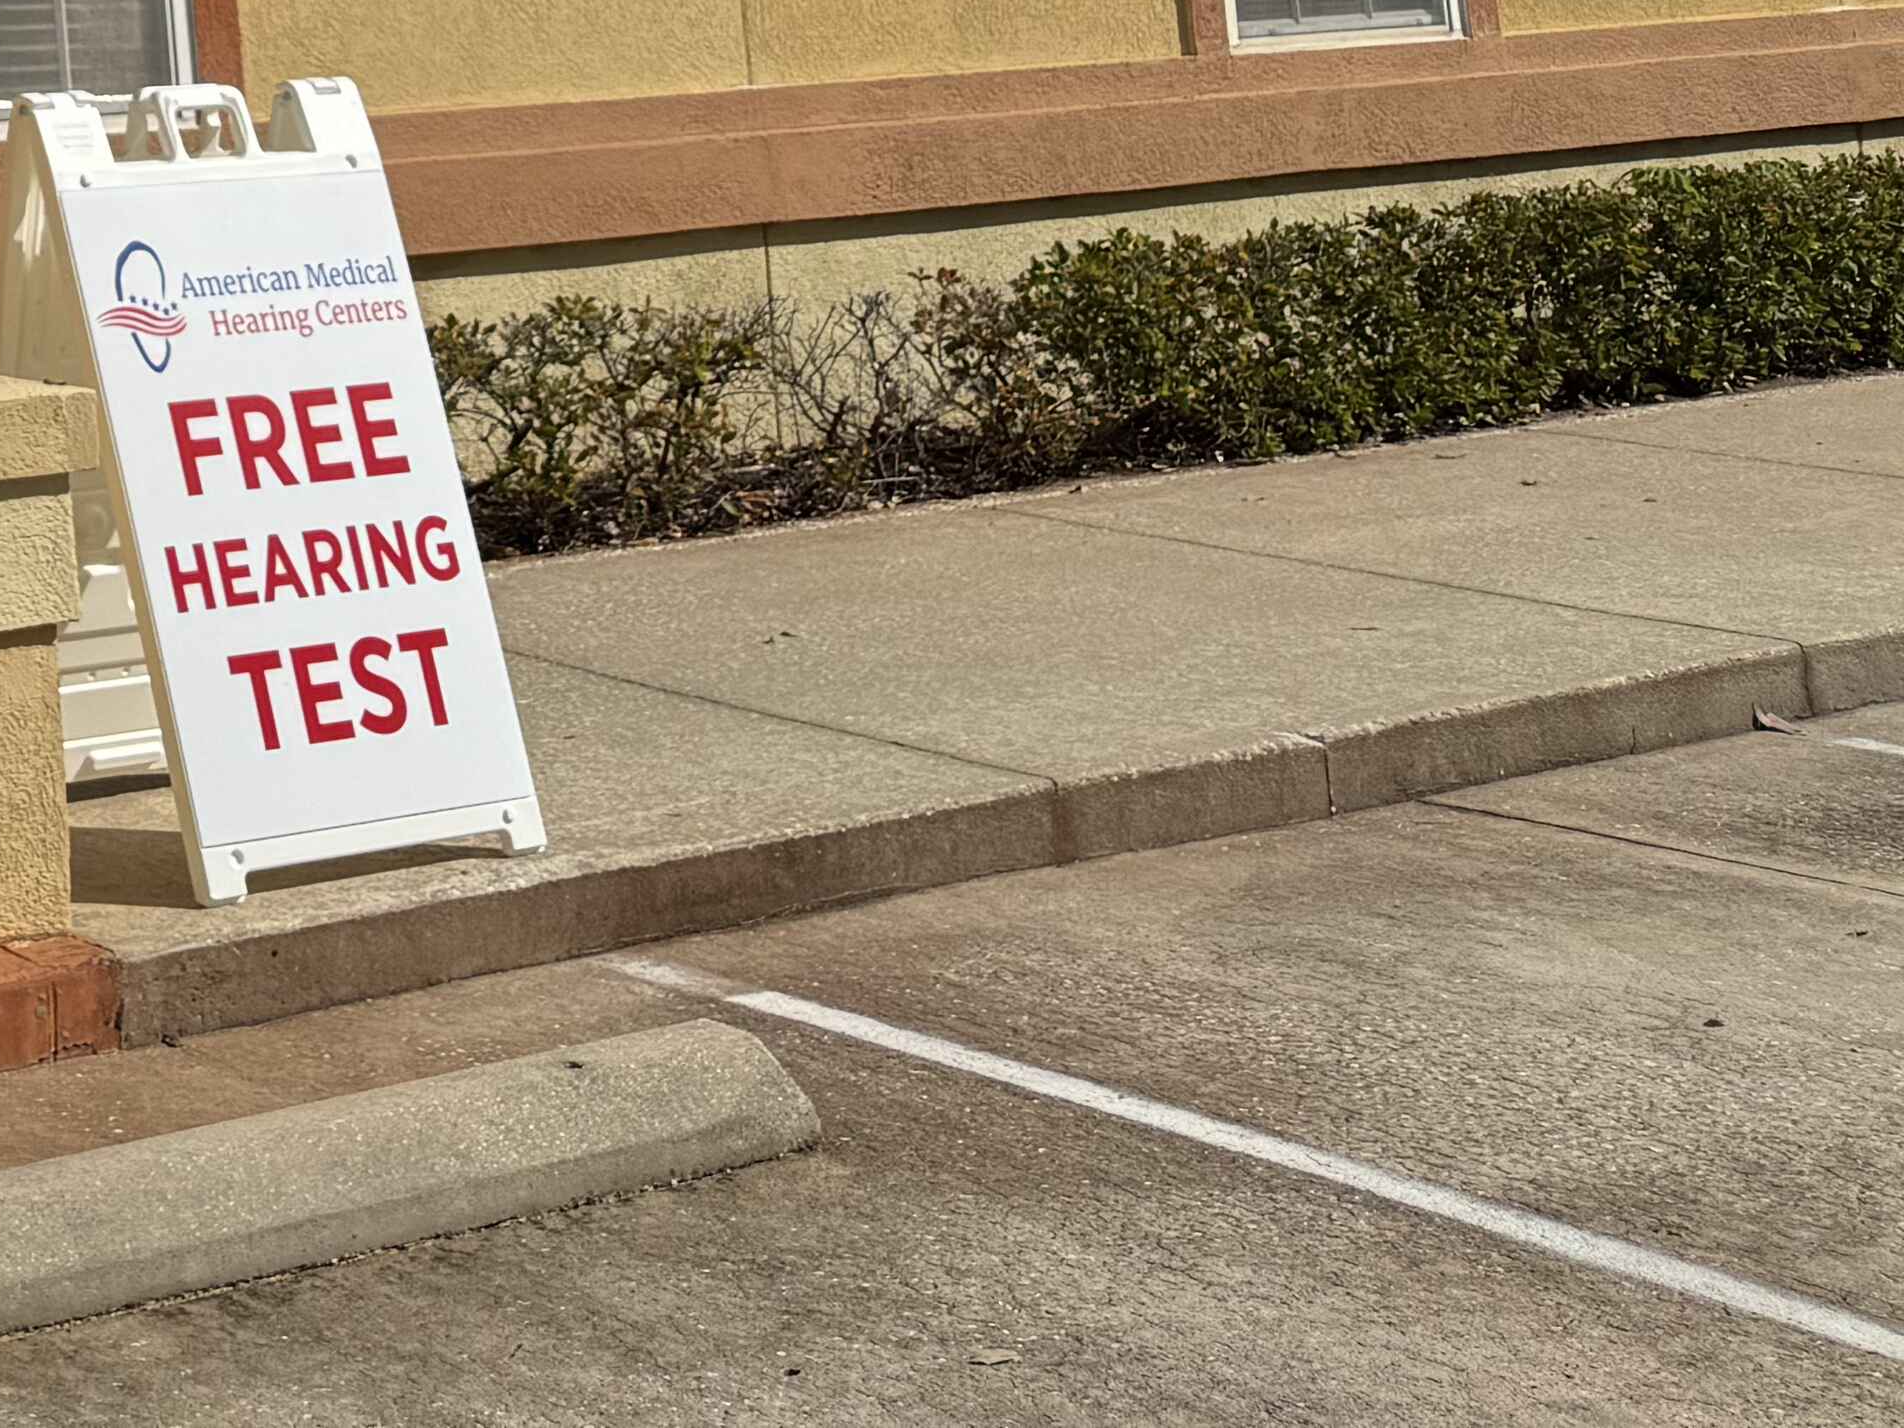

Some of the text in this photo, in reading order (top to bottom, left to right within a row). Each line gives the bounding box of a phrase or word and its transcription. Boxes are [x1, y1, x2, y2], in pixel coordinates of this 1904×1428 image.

[181, 256, 398, 298] American Medical
[209, 298, 408, 337] Hearing Centers
[167, 381, 412, 497] FREE
[163, 515, 462, 614] HEARING
[227, 627, 450, 752] TEST
